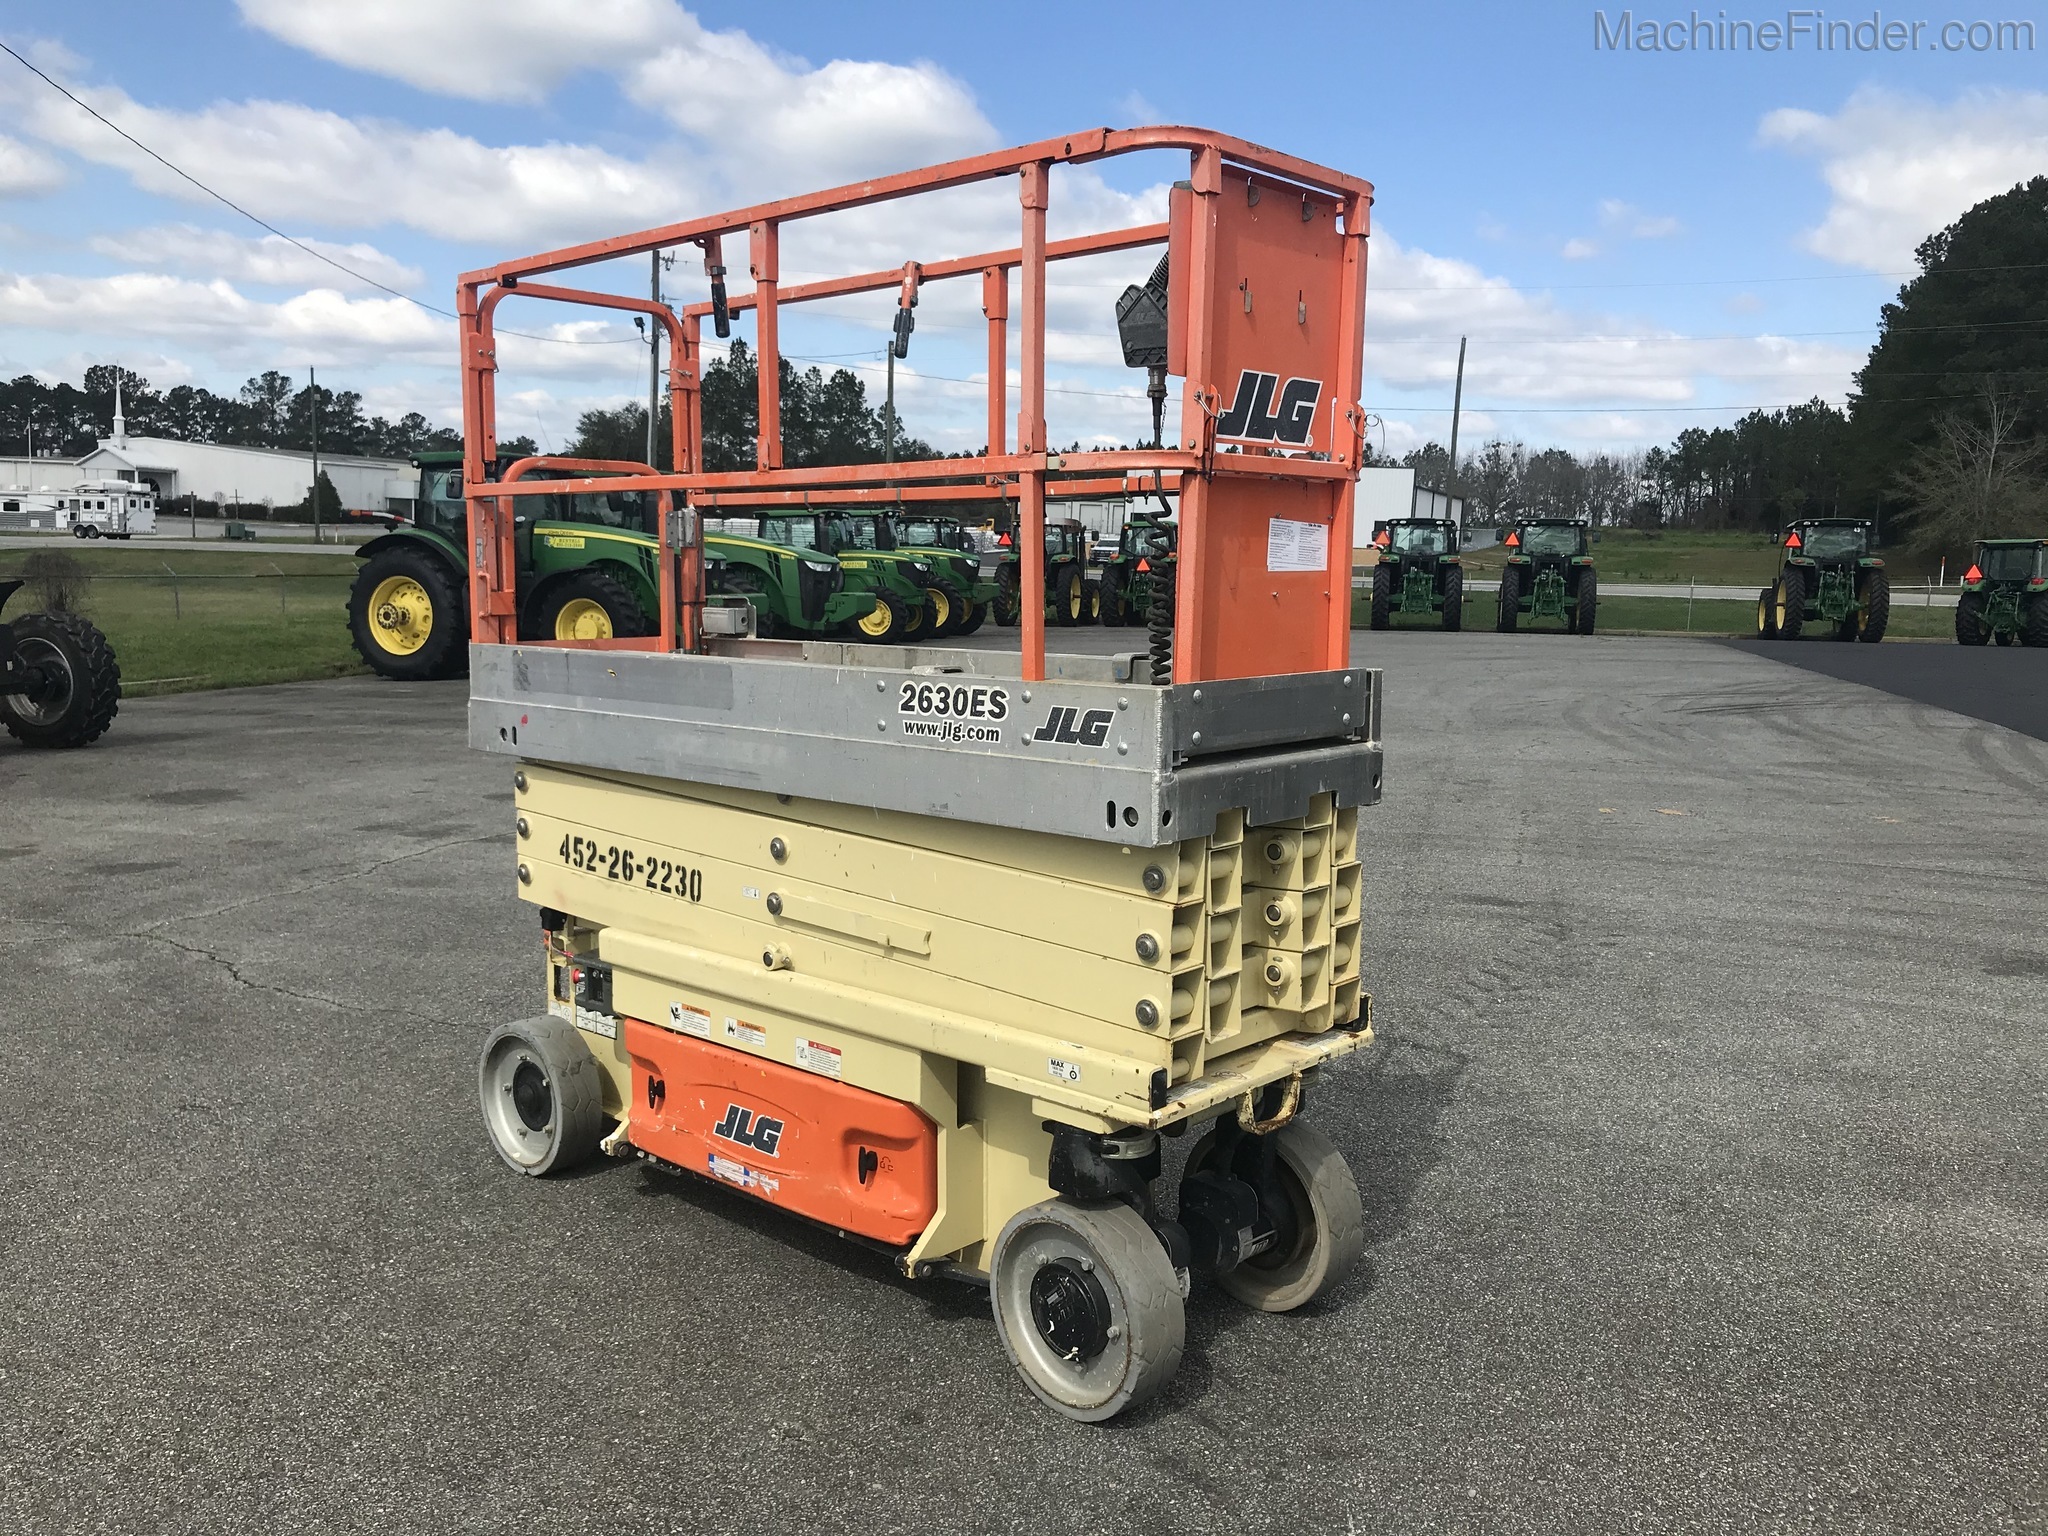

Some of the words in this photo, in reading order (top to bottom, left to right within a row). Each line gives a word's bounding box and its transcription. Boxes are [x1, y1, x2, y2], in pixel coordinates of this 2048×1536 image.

[1216, 370, 1322, 445] JLG
[900, 683, 1008, 720] 2630ES
[903, 721, 1000, 742] www.jlg.com
[1033, 706, 1115, 747] JLG
[560, 833, 702, 902] 452-26-2230
[1050, 1059, 1064, 1068] MAX
[713, 1103, 785, 1156] JLG
